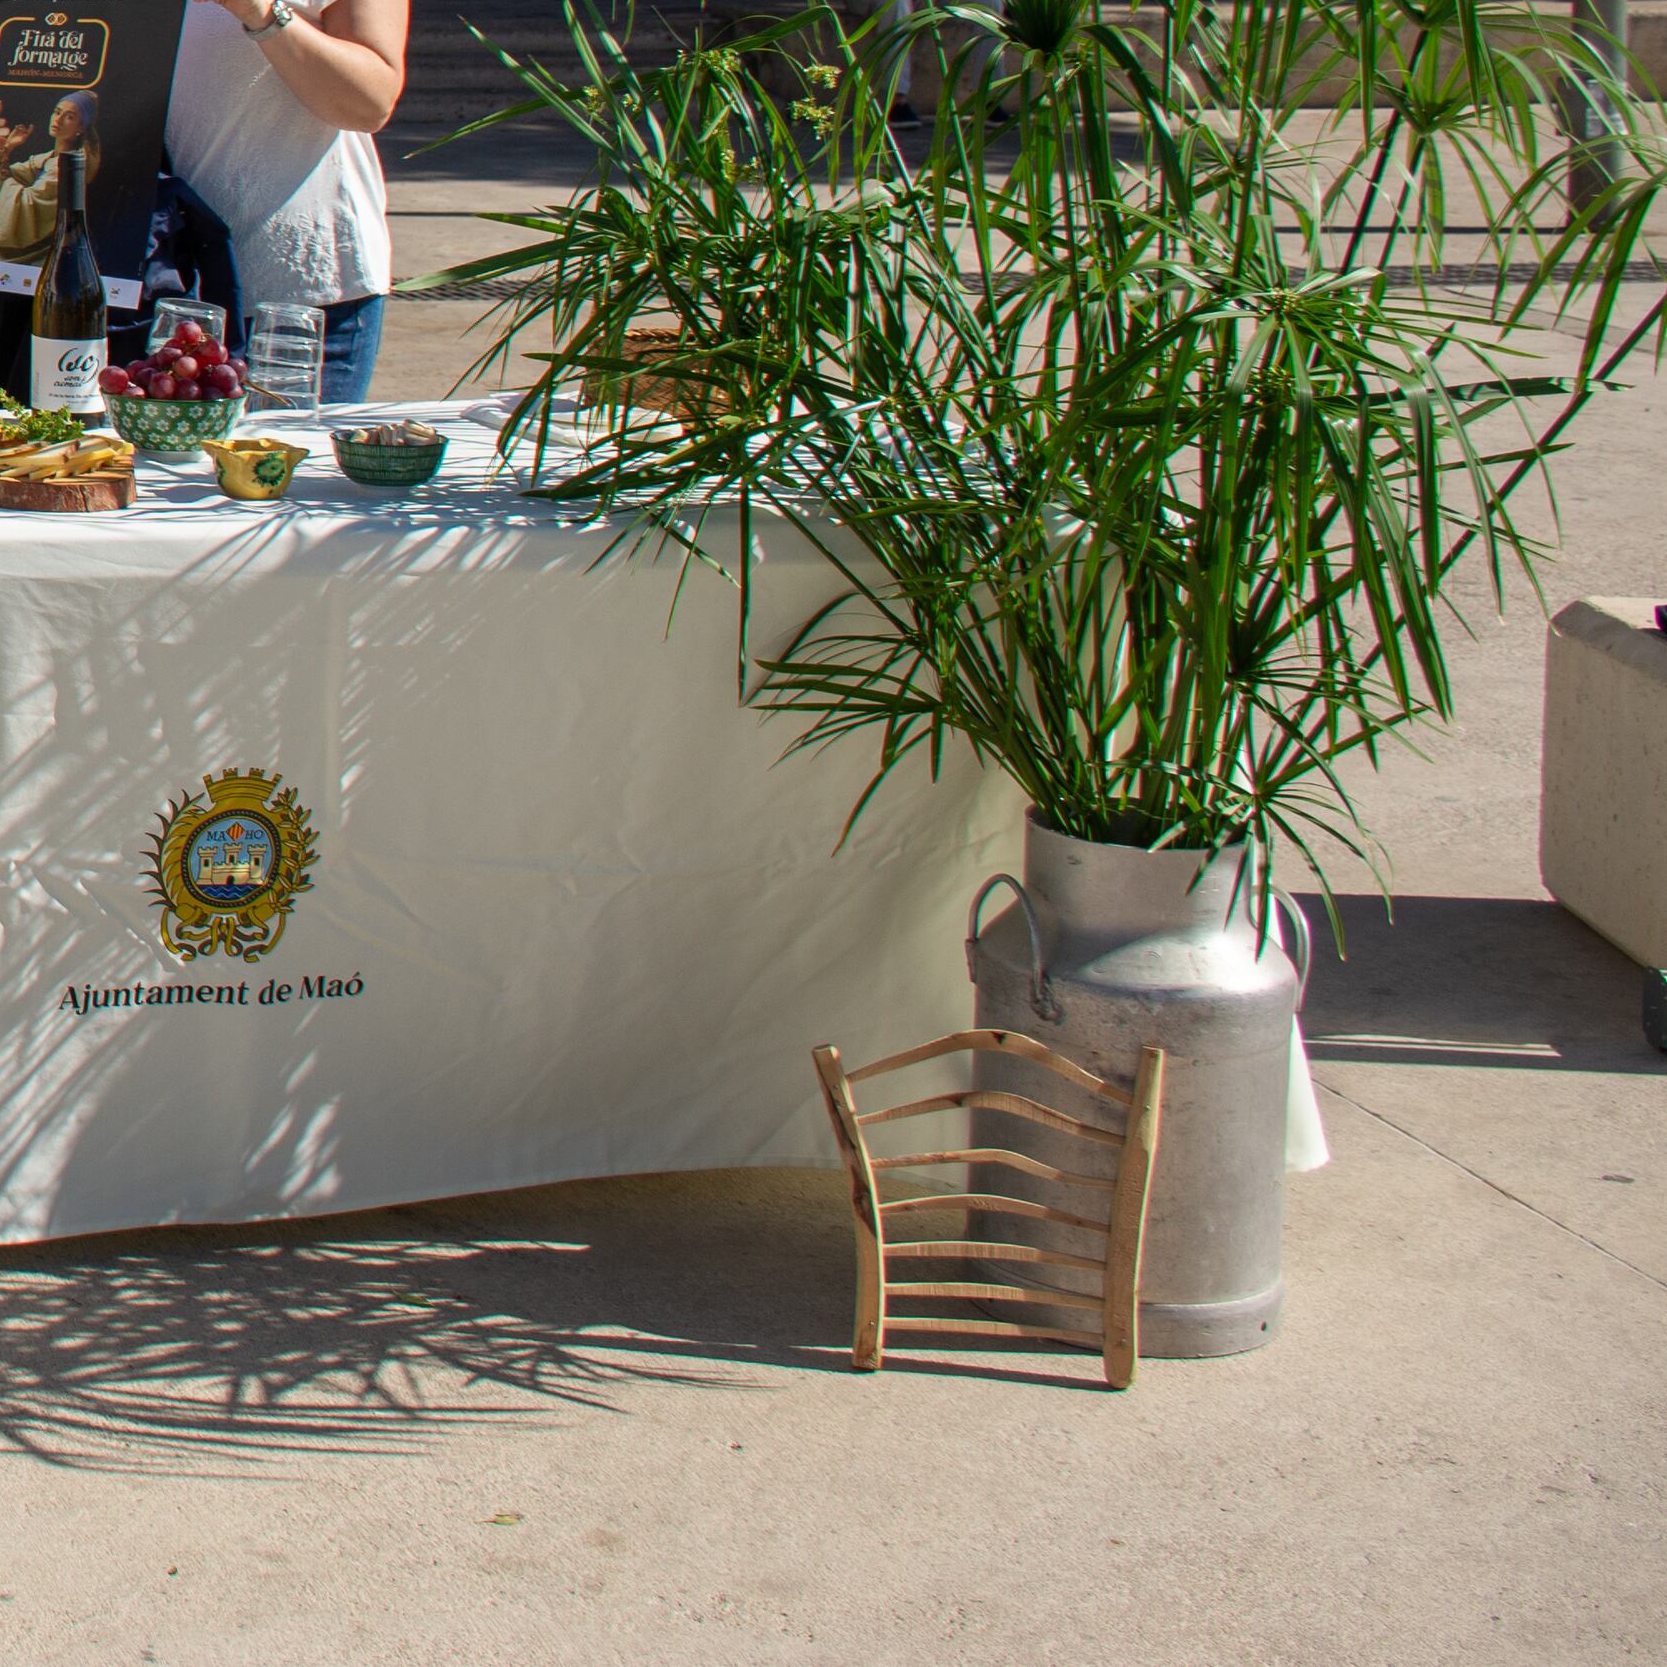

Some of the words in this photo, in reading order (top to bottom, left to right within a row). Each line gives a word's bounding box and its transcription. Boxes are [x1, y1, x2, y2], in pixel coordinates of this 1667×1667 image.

[19, 29, 55, 48] Fira
[59, 30, 84, 49] del
[8, 46, 88, 71] formatge
[206, 831, 226, 842] MA
[244, 829, 264, 840] HO
[58, 981, 249, 1015] Ajuntament
[258, 979, 293, 1005] de
[298, 972, 364, 1000] Maó
